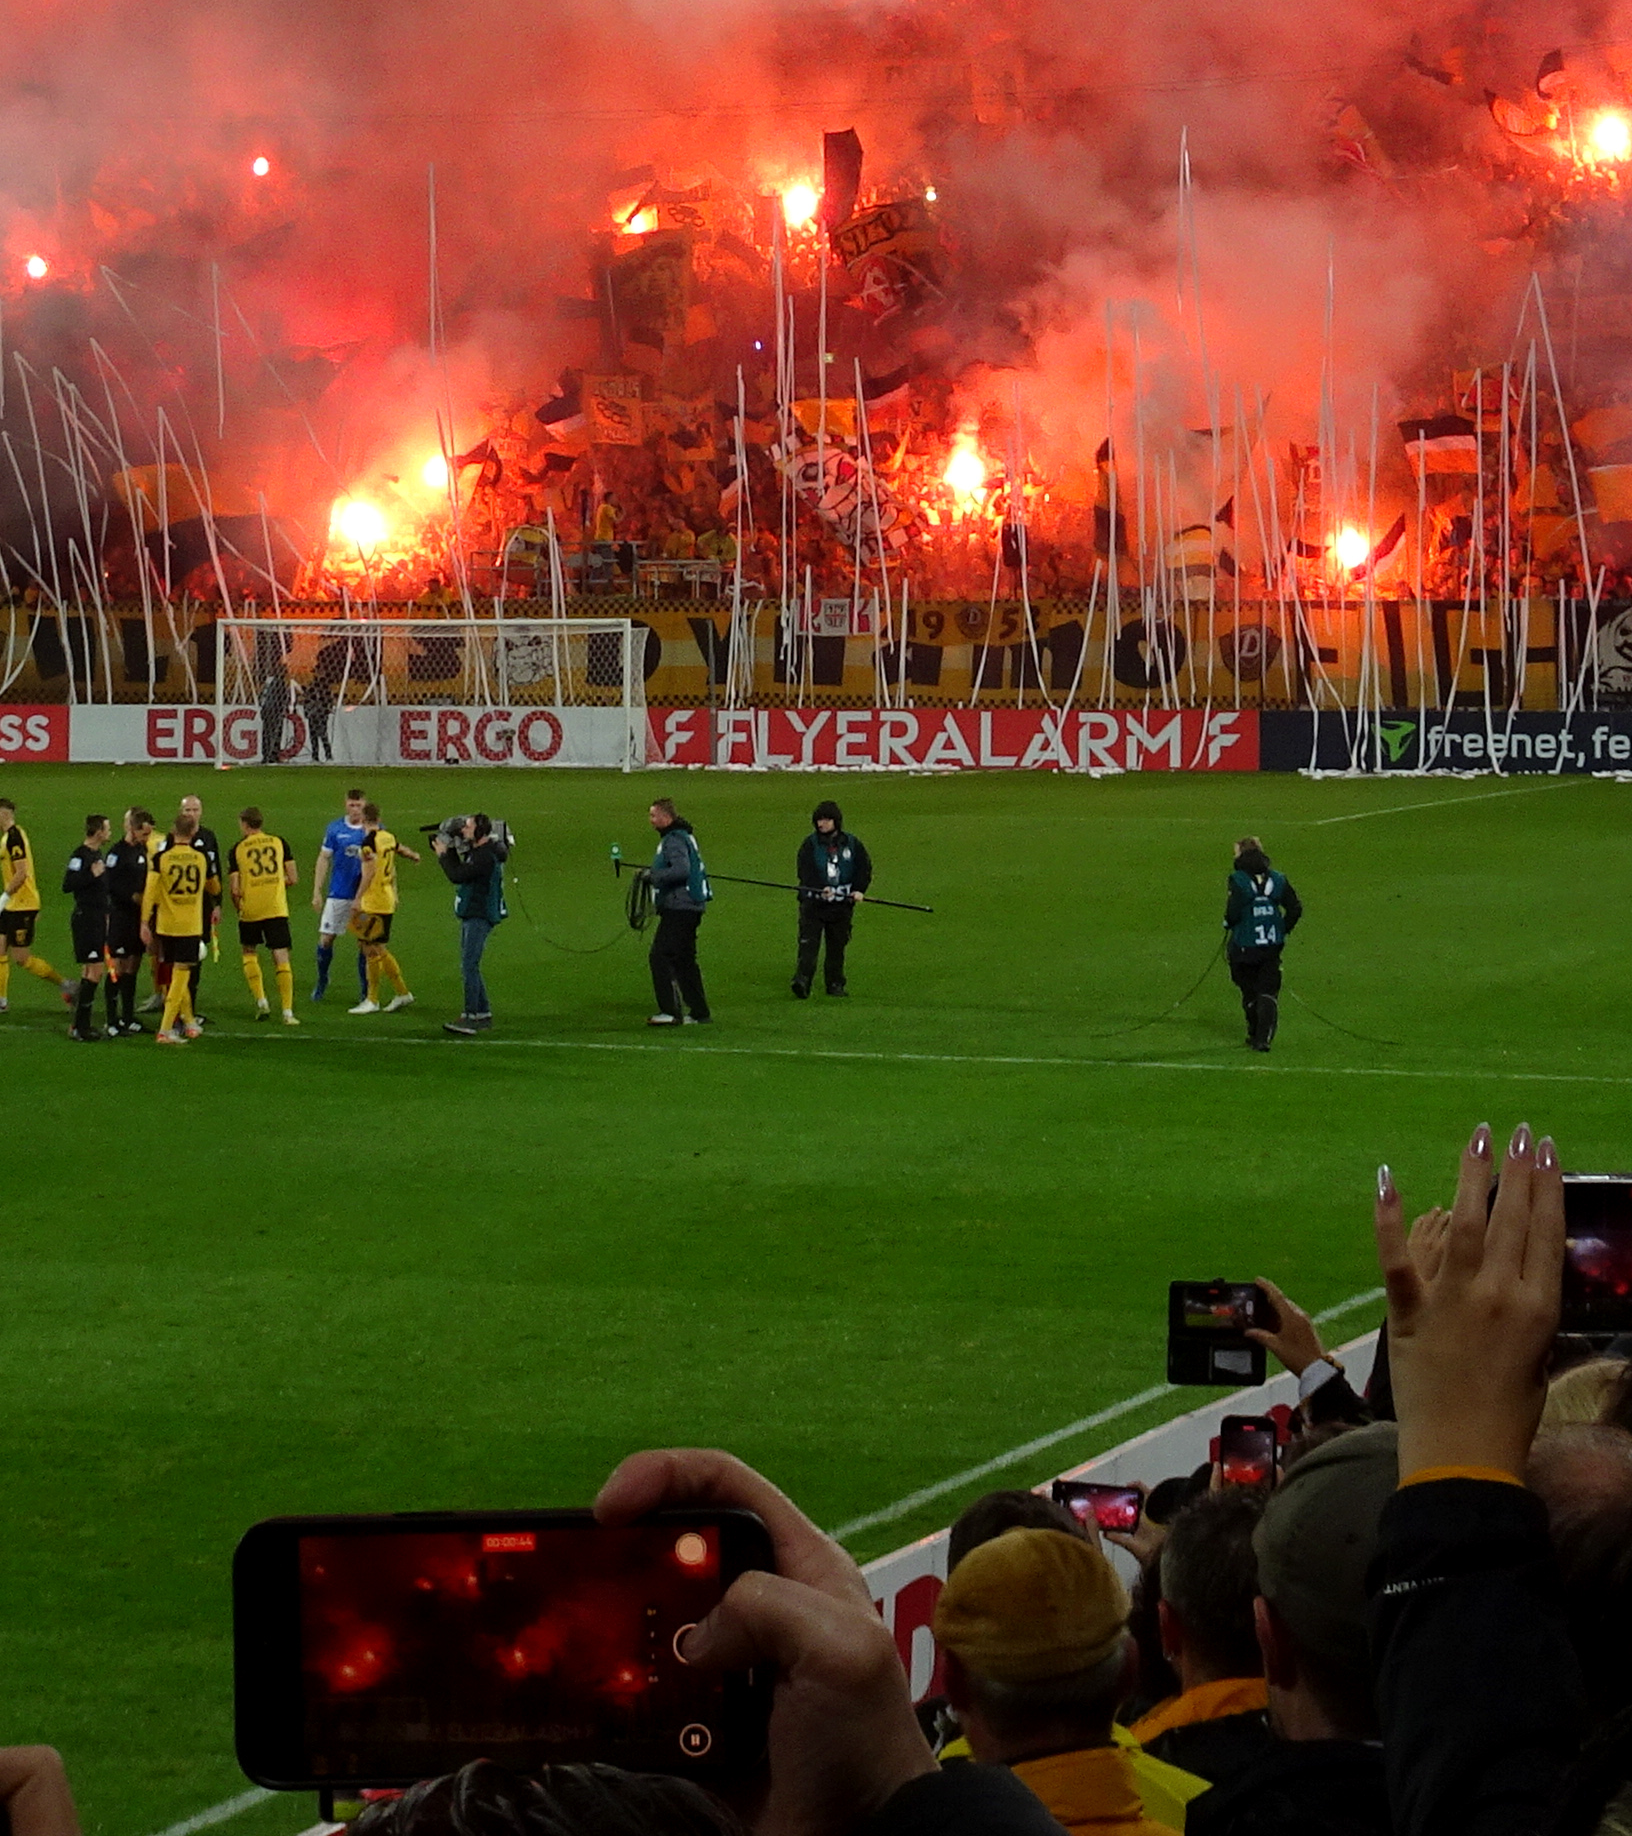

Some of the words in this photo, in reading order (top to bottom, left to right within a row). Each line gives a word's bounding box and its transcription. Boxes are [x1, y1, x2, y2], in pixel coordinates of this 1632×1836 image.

[399, 709, 564, 762] ERGO
[716, 709, 1181, 767] FLYERALARM
[1428, 726, 1586, 768] freenet,
[168, 864, 201, 896] 29
[246, 846, 278, 877] 33
